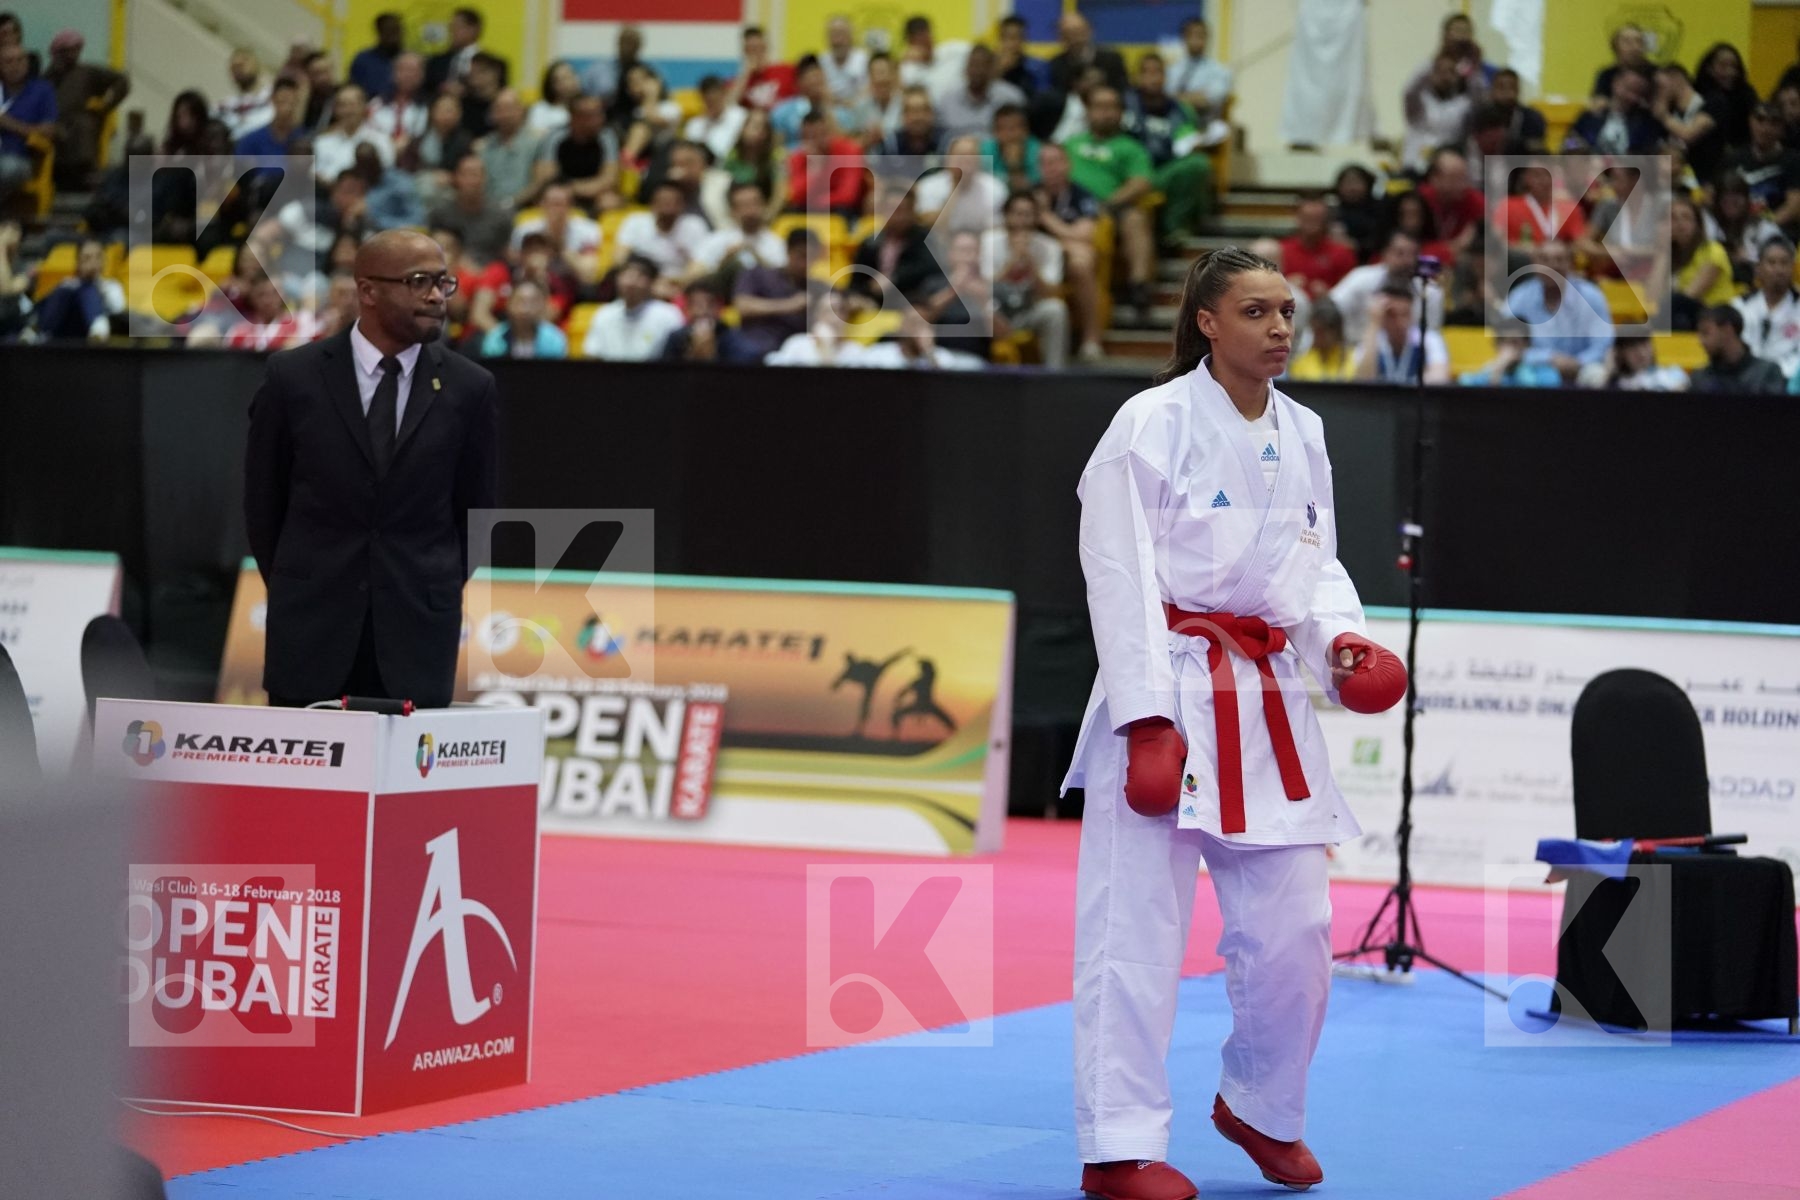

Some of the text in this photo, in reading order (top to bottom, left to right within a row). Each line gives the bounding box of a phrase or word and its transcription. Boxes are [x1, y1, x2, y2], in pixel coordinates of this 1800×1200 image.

[171, 751, 328, 768] PREMIER LEAGUE
[436, 757, 500, 769] PREMIER LEAGUE
[133, 879, 341, 905] Wasl Club 16-18 February 2018
[122, 894, 303, 962] OPEN
[311, 911, 333, 1013] KARATE
[412, 1036, 515, 1072] ARAWAZA.COM
